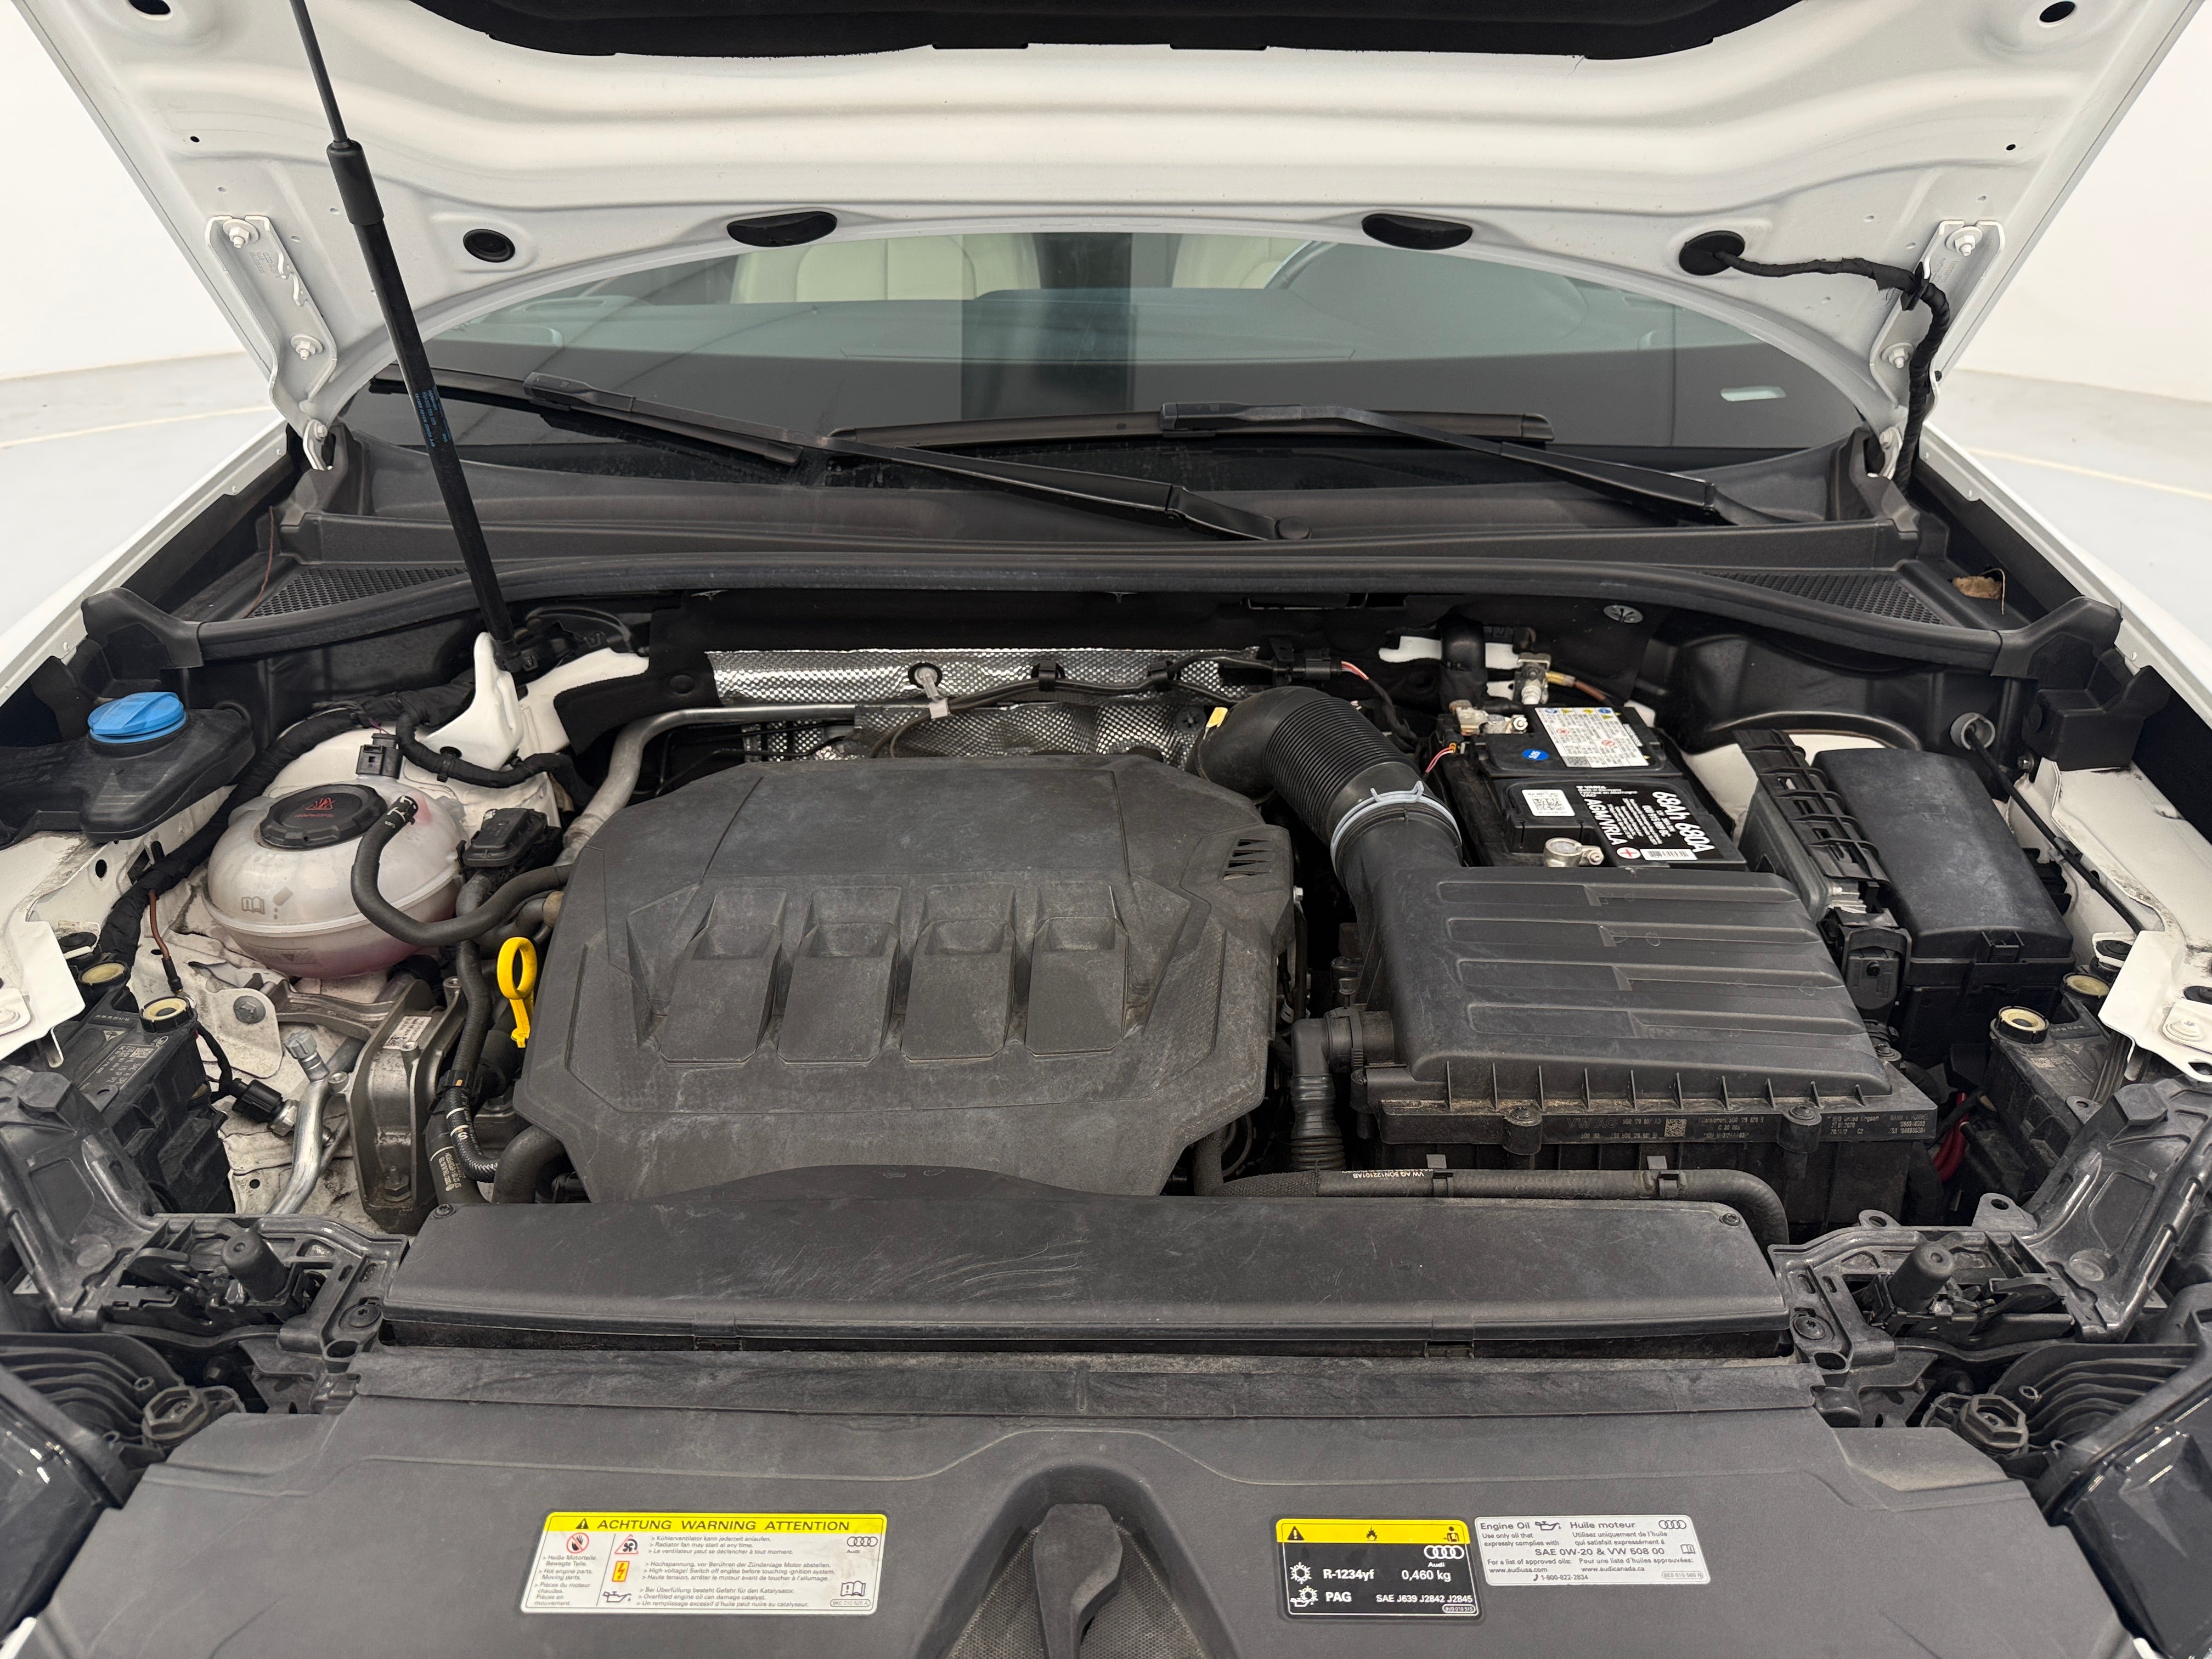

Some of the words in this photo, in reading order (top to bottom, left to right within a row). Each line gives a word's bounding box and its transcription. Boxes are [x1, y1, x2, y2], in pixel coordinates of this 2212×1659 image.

[1652, 791, 1691, 820] 68Ah
[1674, 822, 1716, 853] 680A
[1567, 1118, 1592, 1128] VW
[1594, 1118, 1617, 1128] AG
[597, 1520, 672, 1530] ACHTUNG
[682, 1520, 756, 1530] WARNING
[764, 1521, 850, 1531] ATTENTION
[1480, 1522, 1514, 1531] Engine
[1323, 1568, 1375, 1581] R-1234yf
[1401, 1570, 1434, 1581] 0,460
[1437, 1570, 1451, 1582] kg
[1325, 1592, 1352, 1602] PAG
